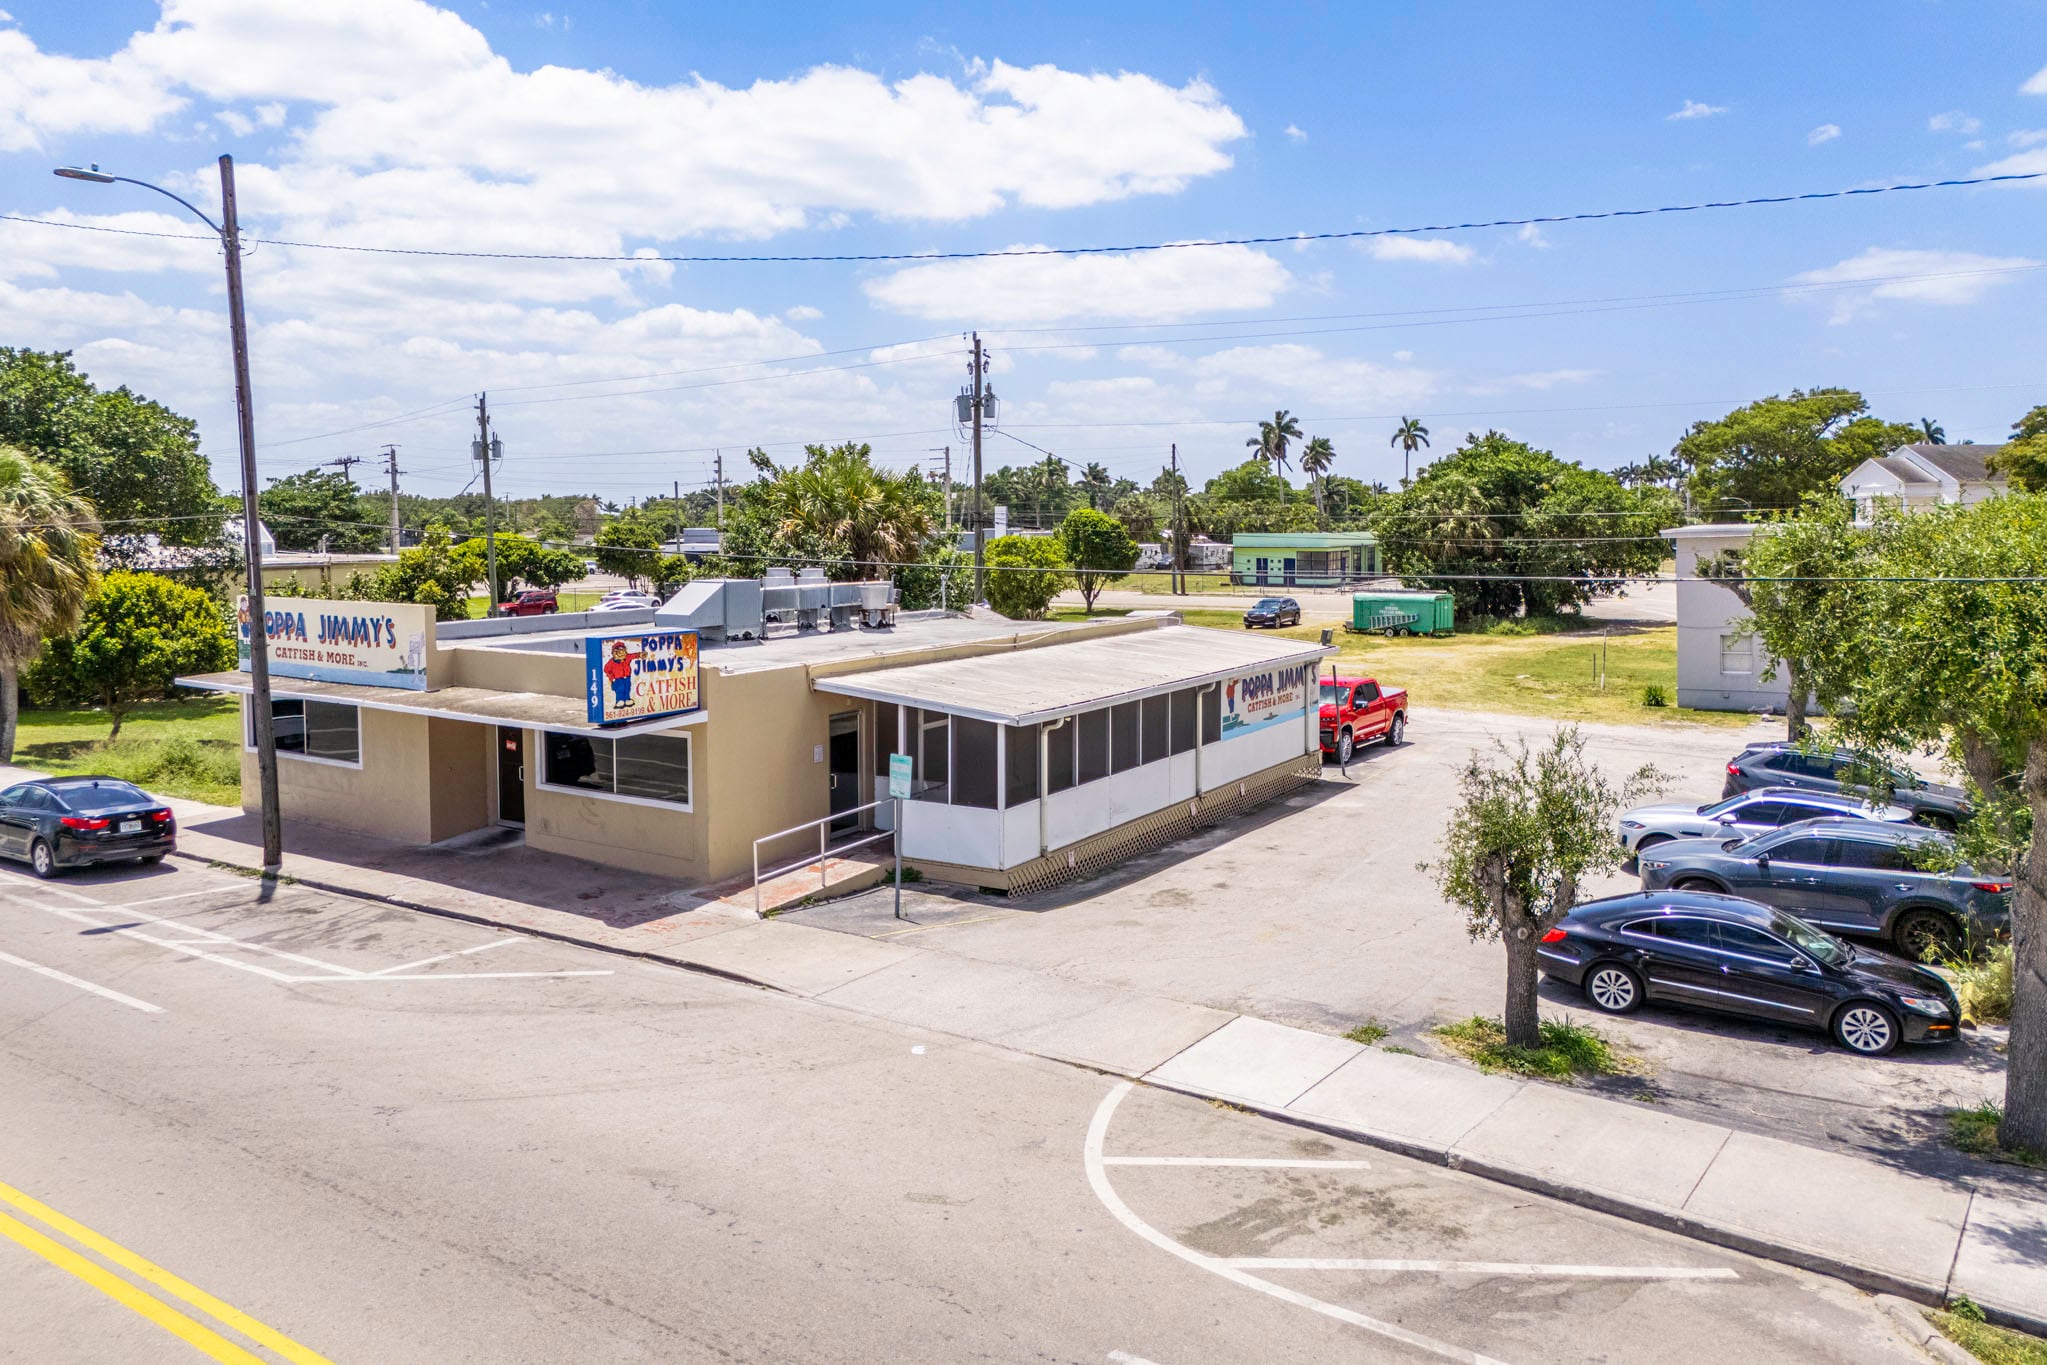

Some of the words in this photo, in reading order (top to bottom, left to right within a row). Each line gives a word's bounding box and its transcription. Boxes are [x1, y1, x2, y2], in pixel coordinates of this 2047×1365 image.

[265, 611, 308, 643] OPPA
[318, 613, 397, 649] JIMMY'S
[641, 635, 683, 652] POPPA
[275, 647, 315, 661] CATFISH
[317, 650, 323, 662] &
[326, 651, 355, 666] MORE
[636, 676, 697, 697] CATFISH
[1242, 672, 1274, 703] POPPA
[647, 697, 656, 713] &
[660, 692, 692, 711] MORE
[1247, 698, 1273, 713] CATFISH
[1277, 693, 1293, 705] MORE
